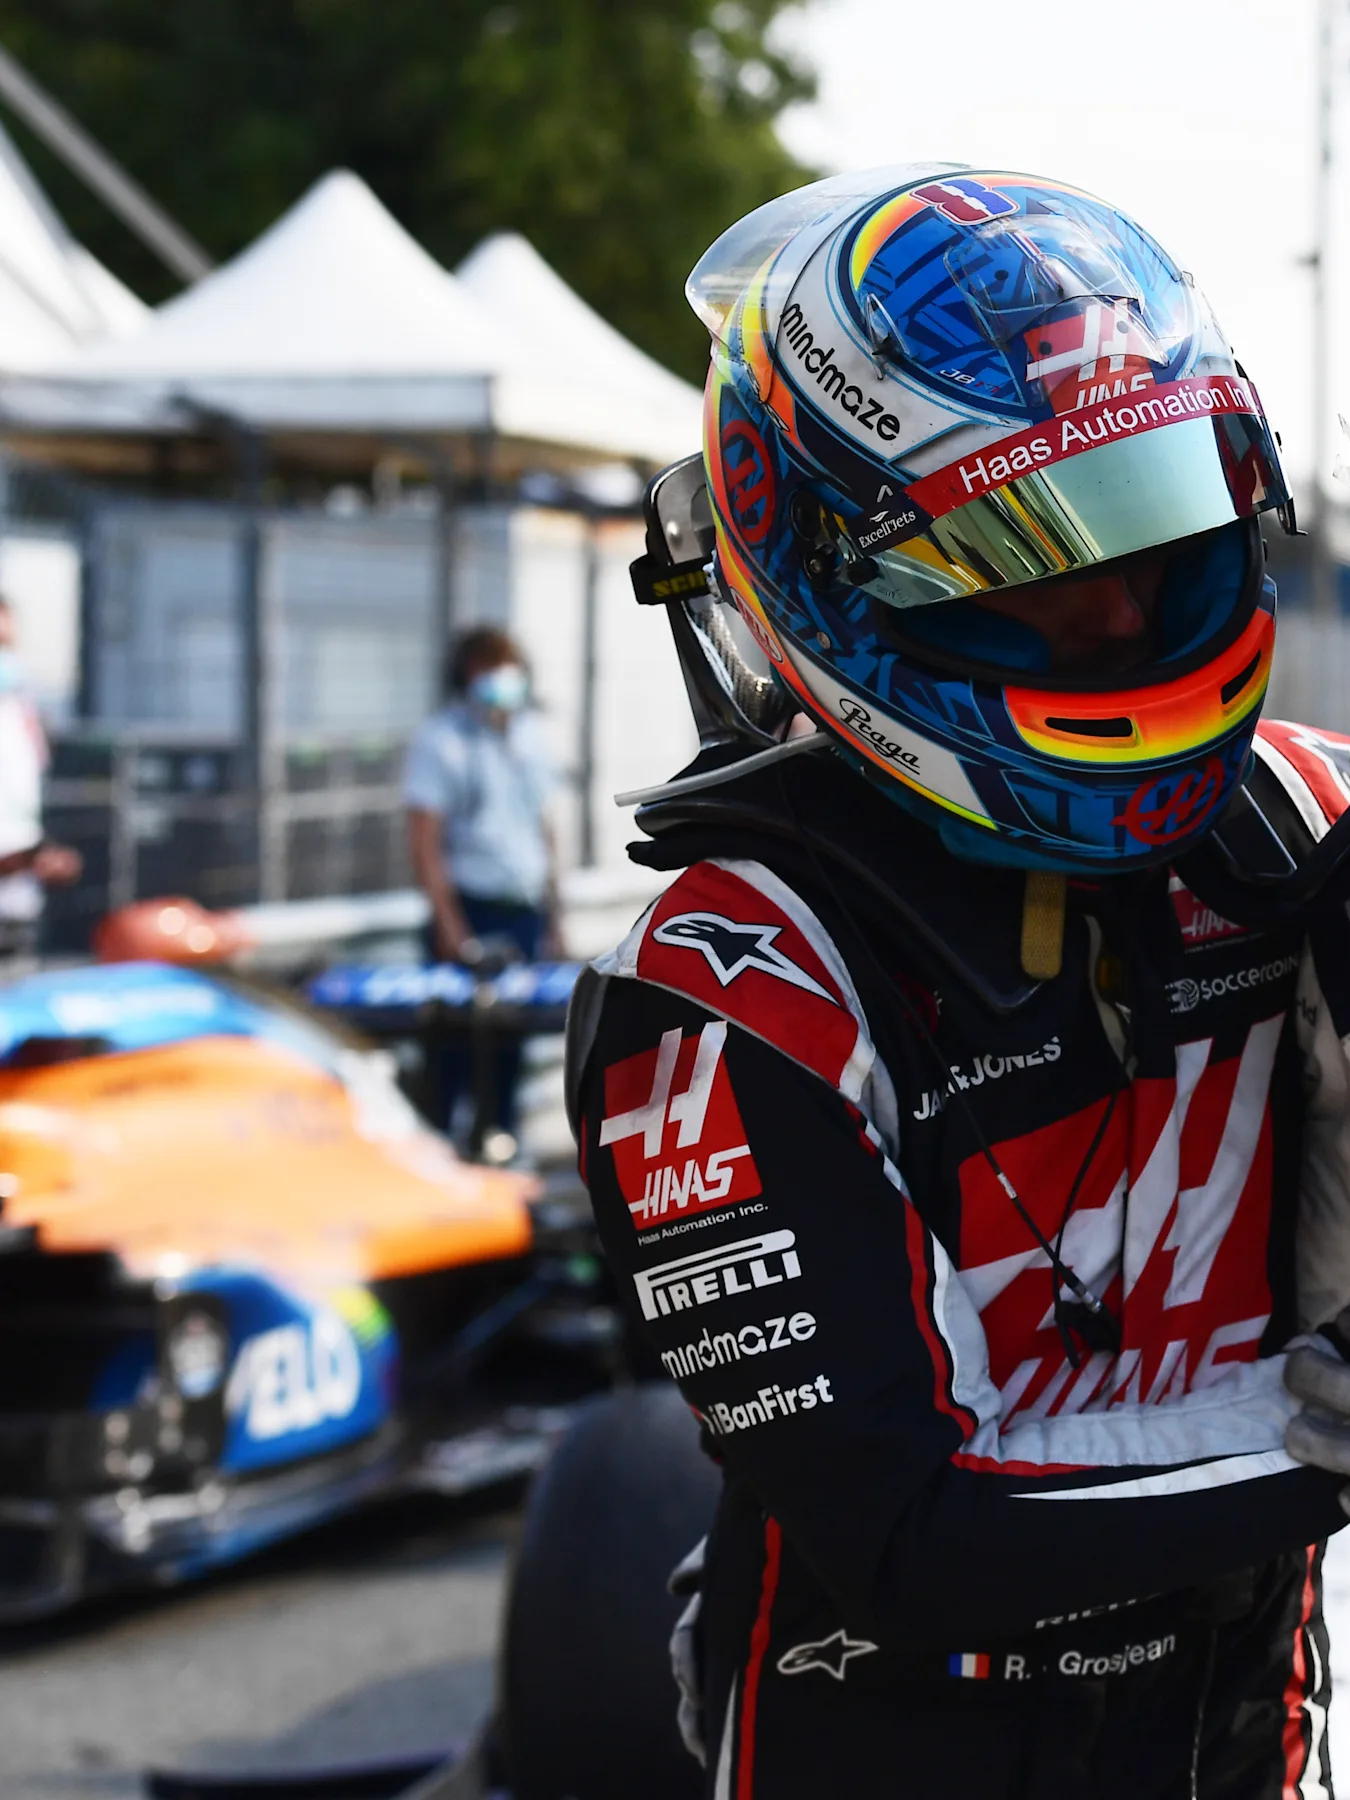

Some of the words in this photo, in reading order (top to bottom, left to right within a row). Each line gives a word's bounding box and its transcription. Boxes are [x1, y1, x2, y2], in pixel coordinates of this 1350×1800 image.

[781, 303, 901, 441] mindmaze
[958, 436, 1052, 493] Haas
[1061, 384, 1226, 452] Automation
[839, 698, 921, 775] Praga
[661, 1211, 736, 1239] Automation
[738, 1202, 769, 1219] Inc.
[632, 1228, 802, 1321] PIRELLI
[661, 1311, 817, 1380] mindmaze
[1058, 1634, 1176, 1675] Grosjean
